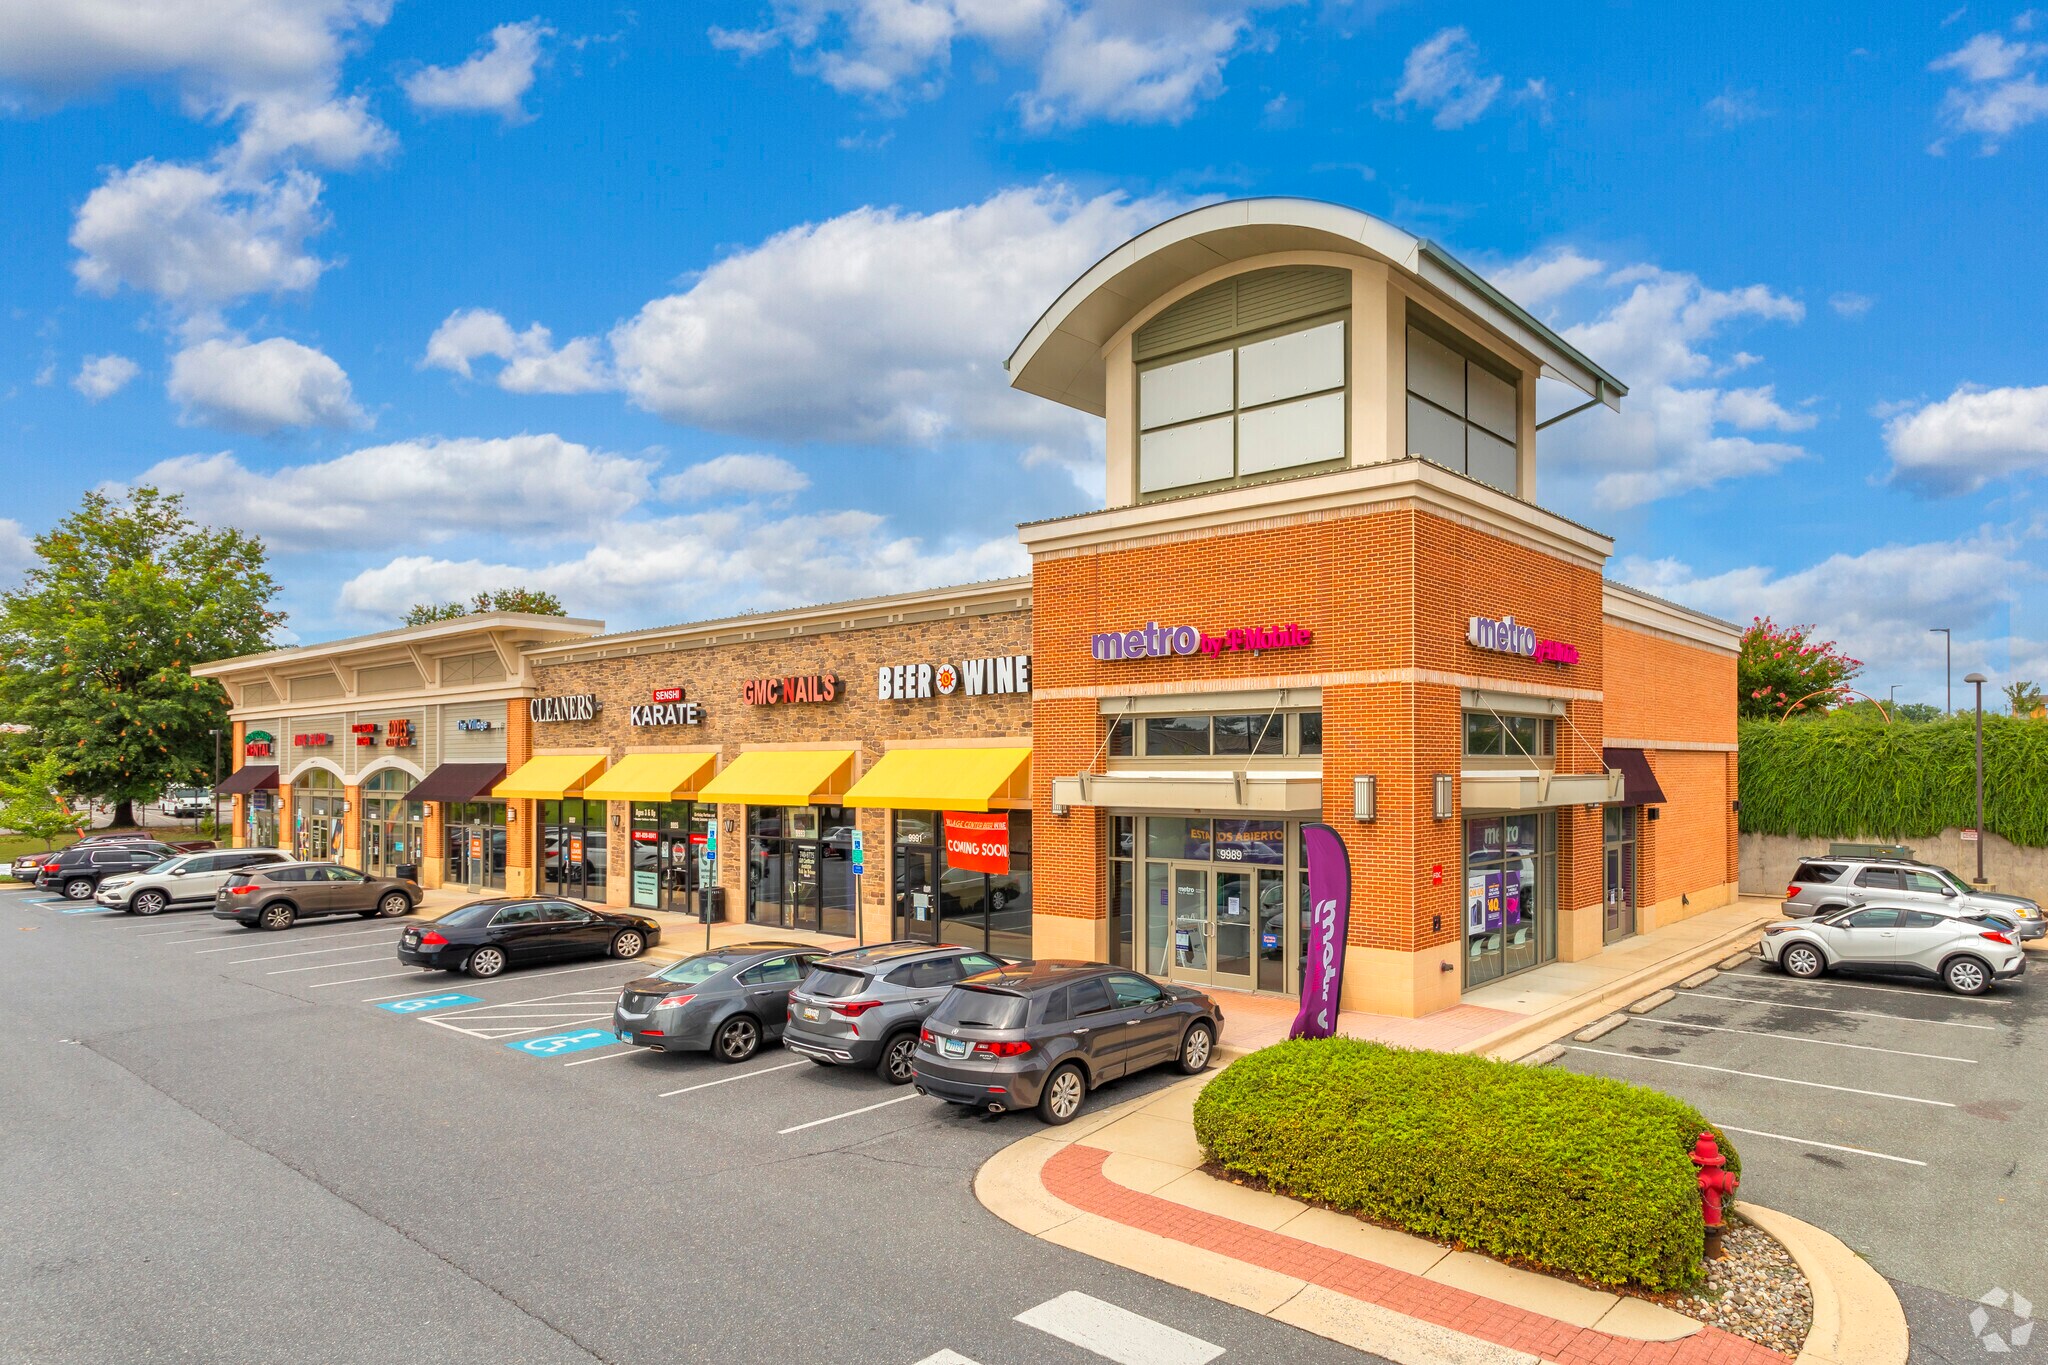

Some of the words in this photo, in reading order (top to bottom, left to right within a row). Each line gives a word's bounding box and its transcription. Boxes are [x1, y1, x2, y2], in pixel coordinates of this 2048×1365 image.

[1092, 621, 1199, 659] metro
[1200, 634, 1224, 658] by
[1476, 616, 1536, 656] metro
[878, 663, 932, 700] BEER
[962, 655, 1029, 696] WINE
[655, 690, 679, 700] SENSHI
[743, 679, 778, 705] GMC
[783, 674, 835, 703] NAILS
[530, 695, 593, 722] CLEANERS
[630, 703, 698, 726] KARATE
[468, 719, 488, 731] Village
[245, 744, 269, 757] DENTAL
[964, 820, 982, 830] CENTER
[1484, 825, 1519, 844] mero
[908, 834, 922, 842] 9991
[1190, 829, 1233, 842] ESTAOS
[947, 839, 980, 855] COMING
[981, 843, 1008, 858] SOON
[1220, 850, 1242, 860] 9989
